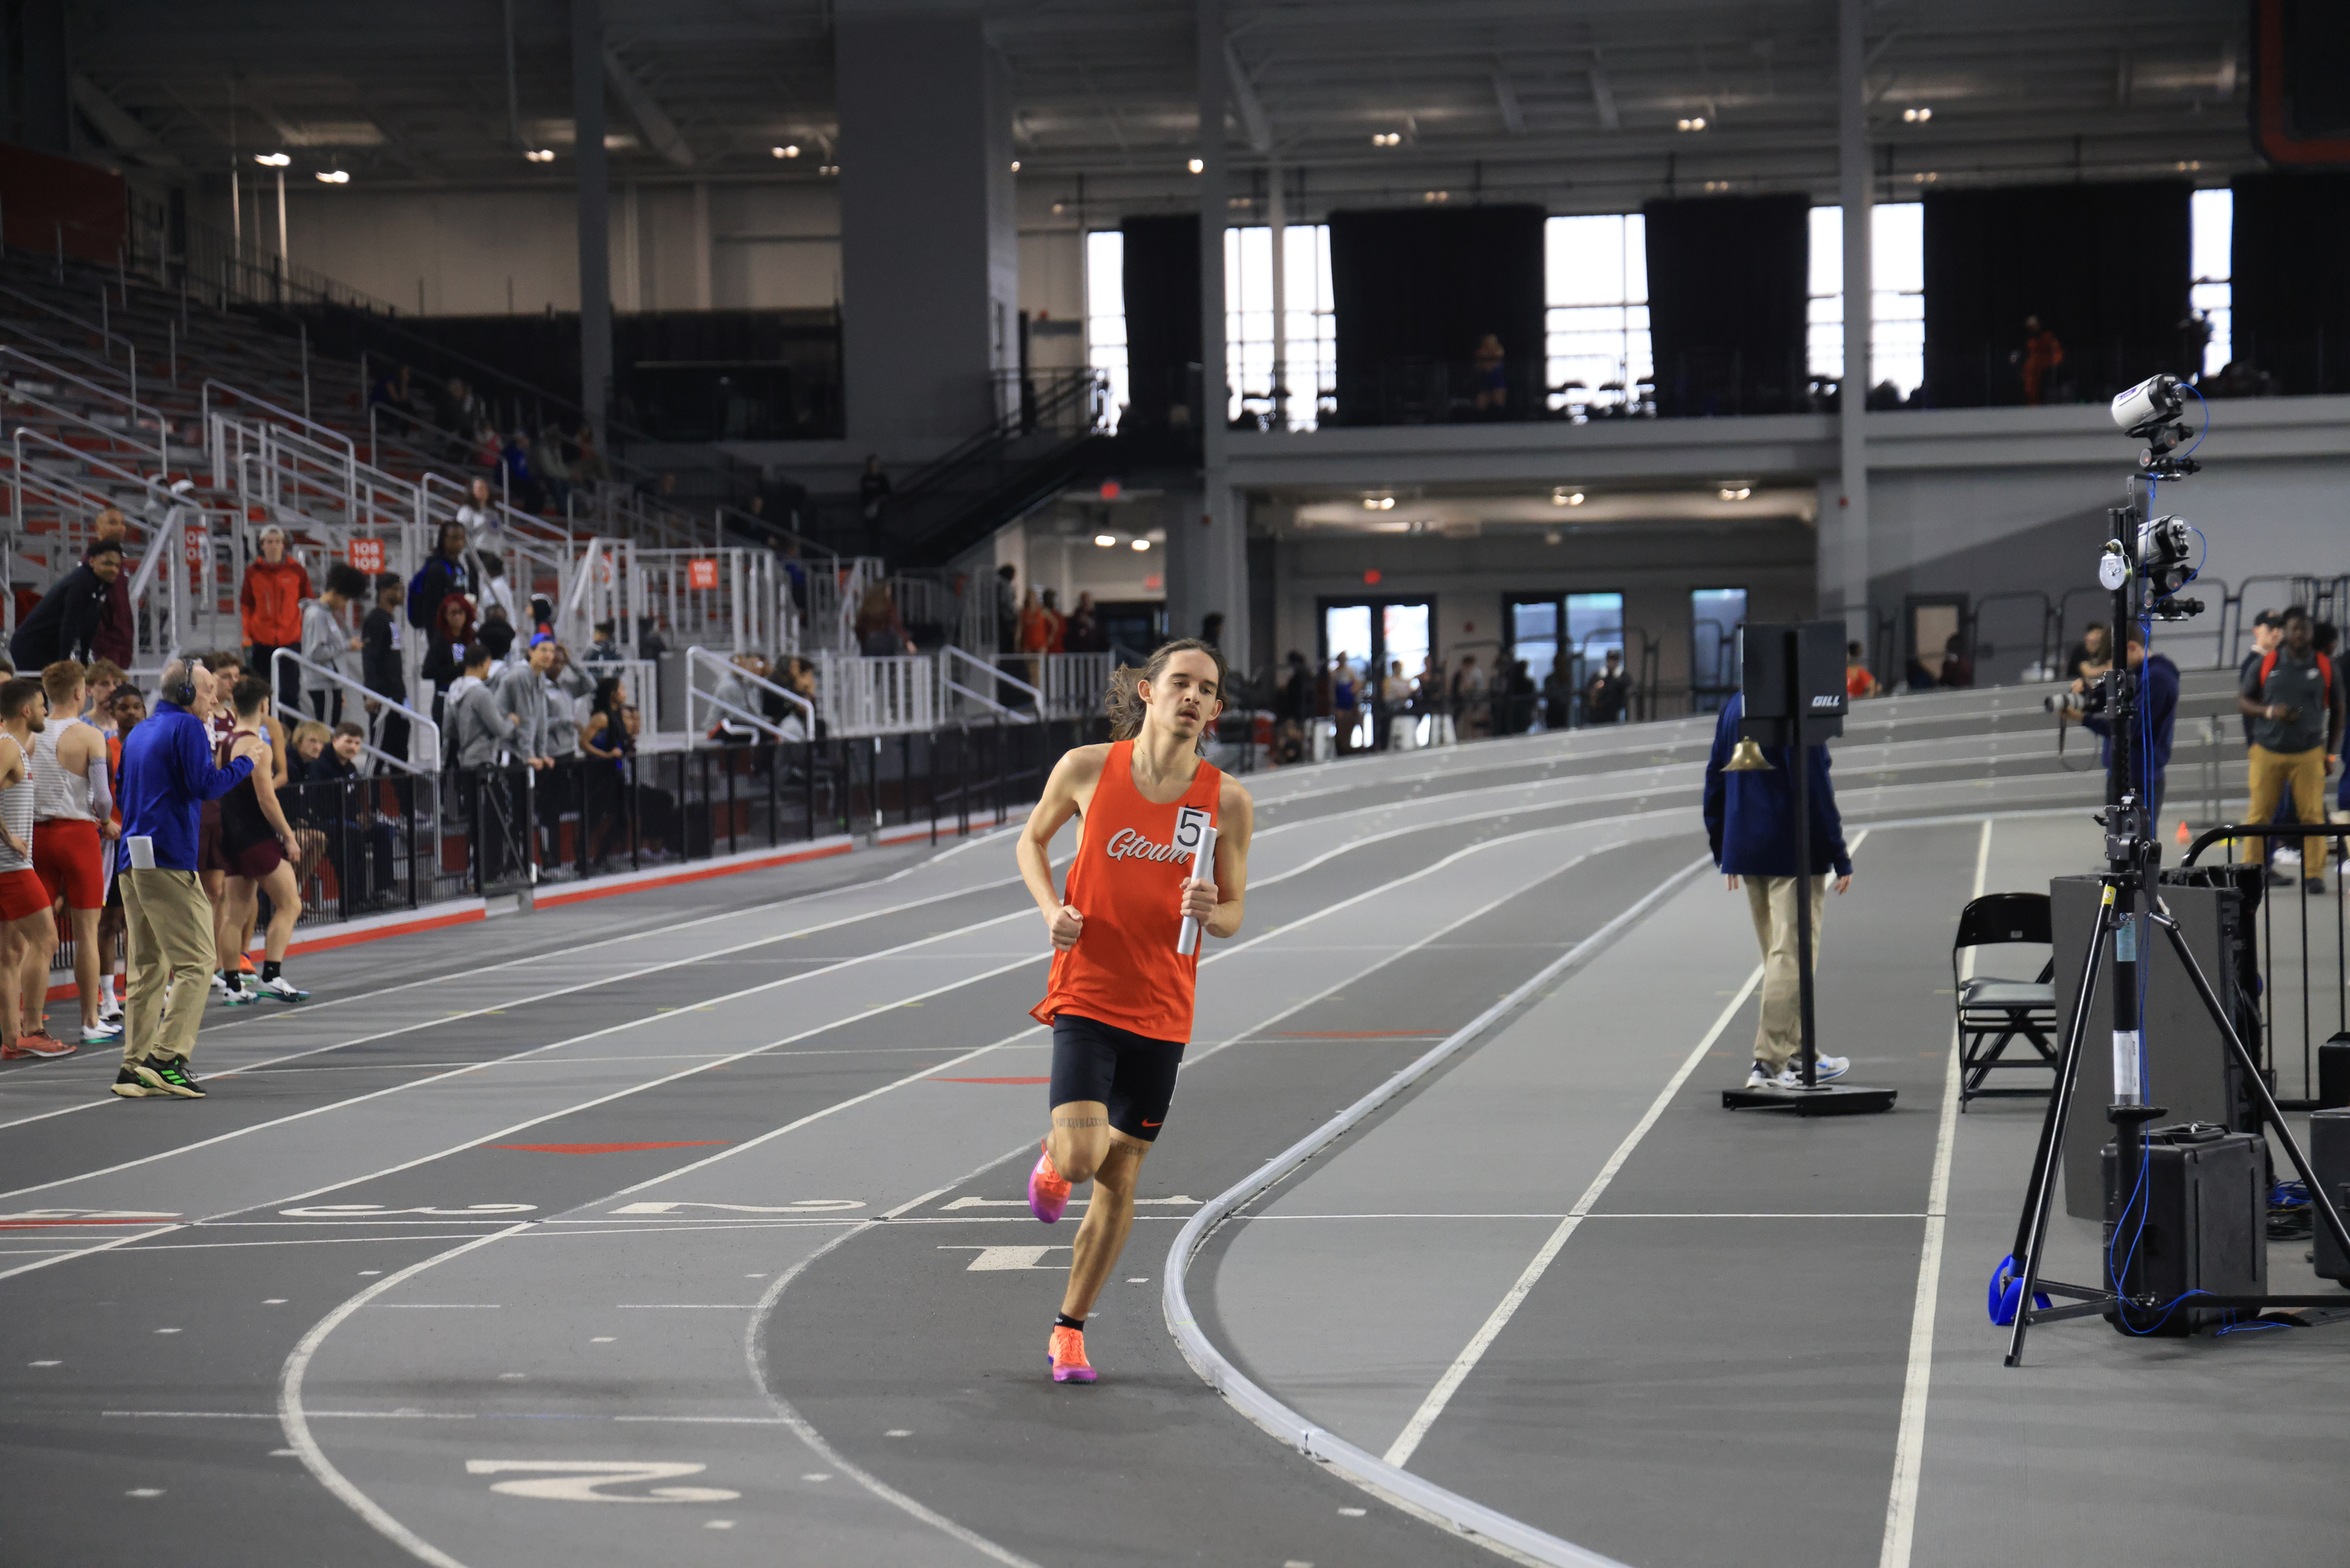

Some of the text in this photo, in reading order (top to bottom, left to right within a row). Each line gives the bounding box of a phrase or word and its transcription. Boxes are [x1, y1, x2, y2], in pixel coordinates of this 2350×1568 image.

[353, 541, 380, 556] 108
[353, 556, 381, 571] 109
[1812, 695, 1840, 707] GILL
[1177, 810, 1204, 847] 5
[1107, 828, 1190, 865] Gtown
